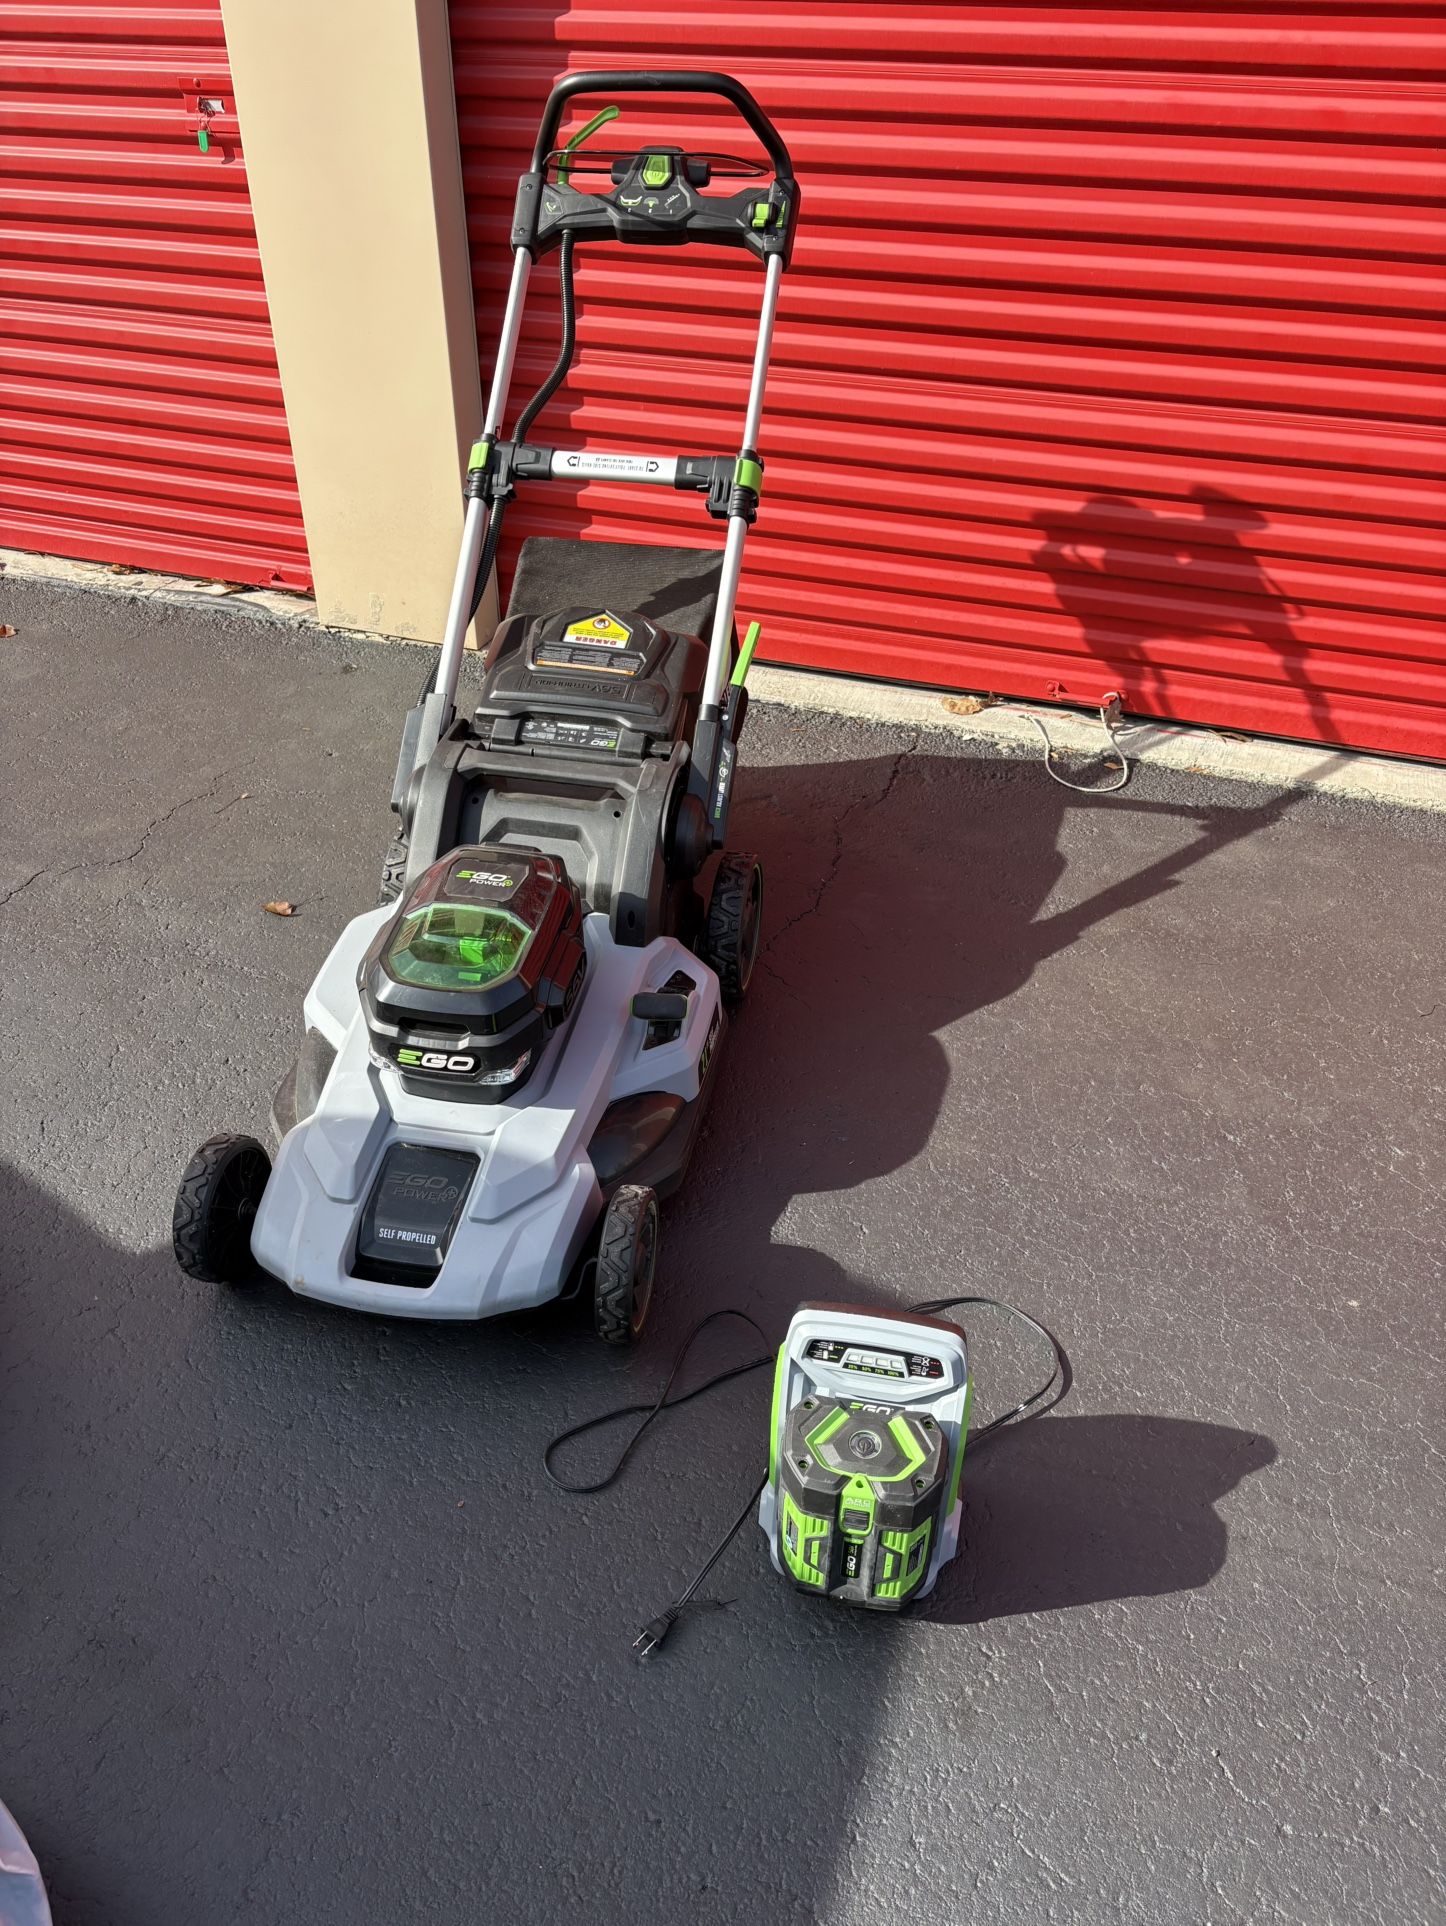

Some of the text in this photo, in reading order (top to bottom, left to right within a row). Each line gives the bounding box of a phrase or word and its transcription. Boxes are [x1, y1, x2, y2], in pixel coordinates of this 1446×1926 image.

[575, 636, 617, 646] DANGER
[592, 683, 621, 695] 56V
[591, 739, 616, 748] EGO
[456, 870, 507, 881] EGO
[397, 1049, 474, 1071] EGO
[386, 1172, 448, 1188] EGO
[379, 1228, 436, 1244] SELF PROPELLED
